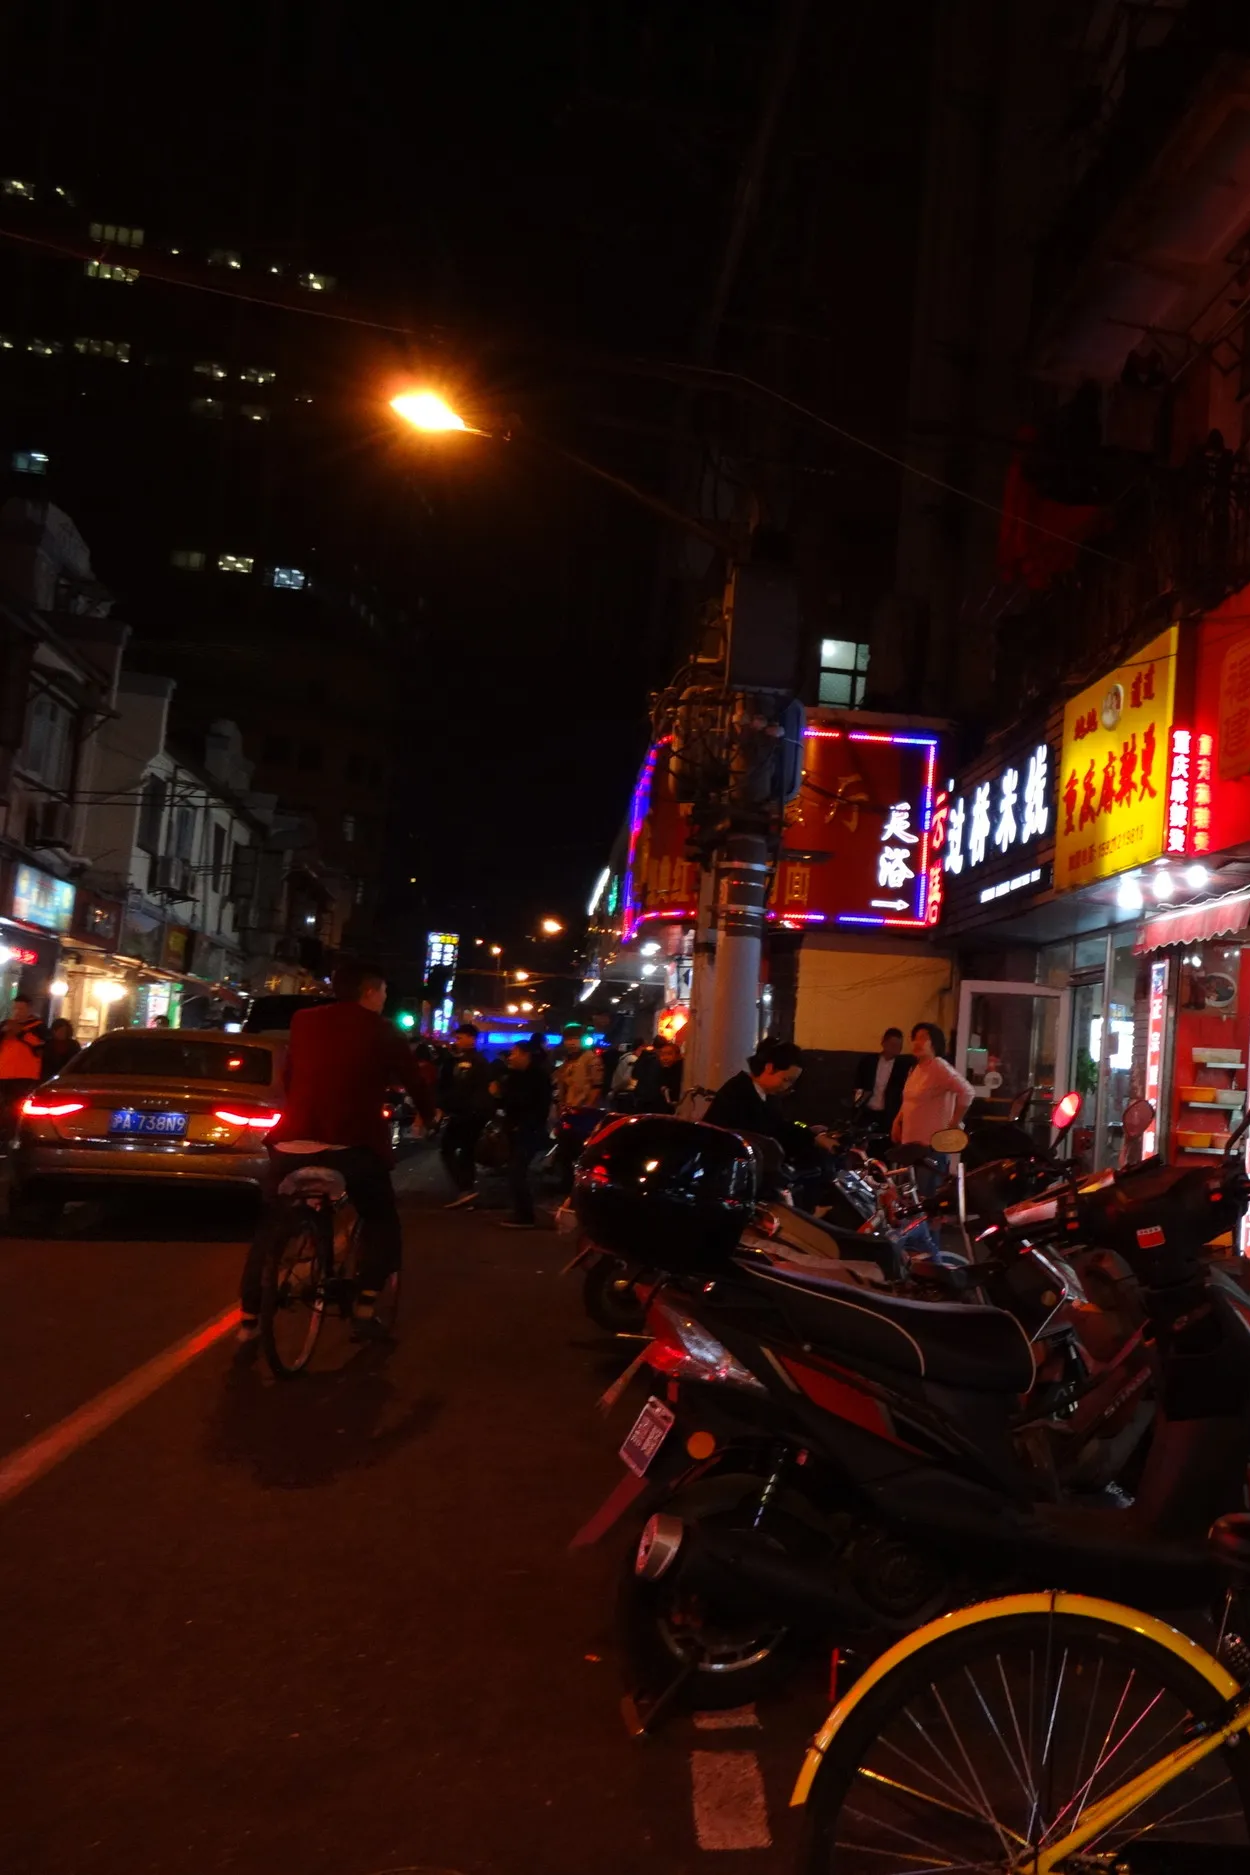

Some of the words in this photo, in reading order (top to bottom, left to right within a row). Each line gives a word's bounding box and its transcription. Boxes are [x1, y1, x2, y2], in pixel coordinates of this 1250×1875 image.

[1062, 722, 1158, 836] 重庆麻辣烫
